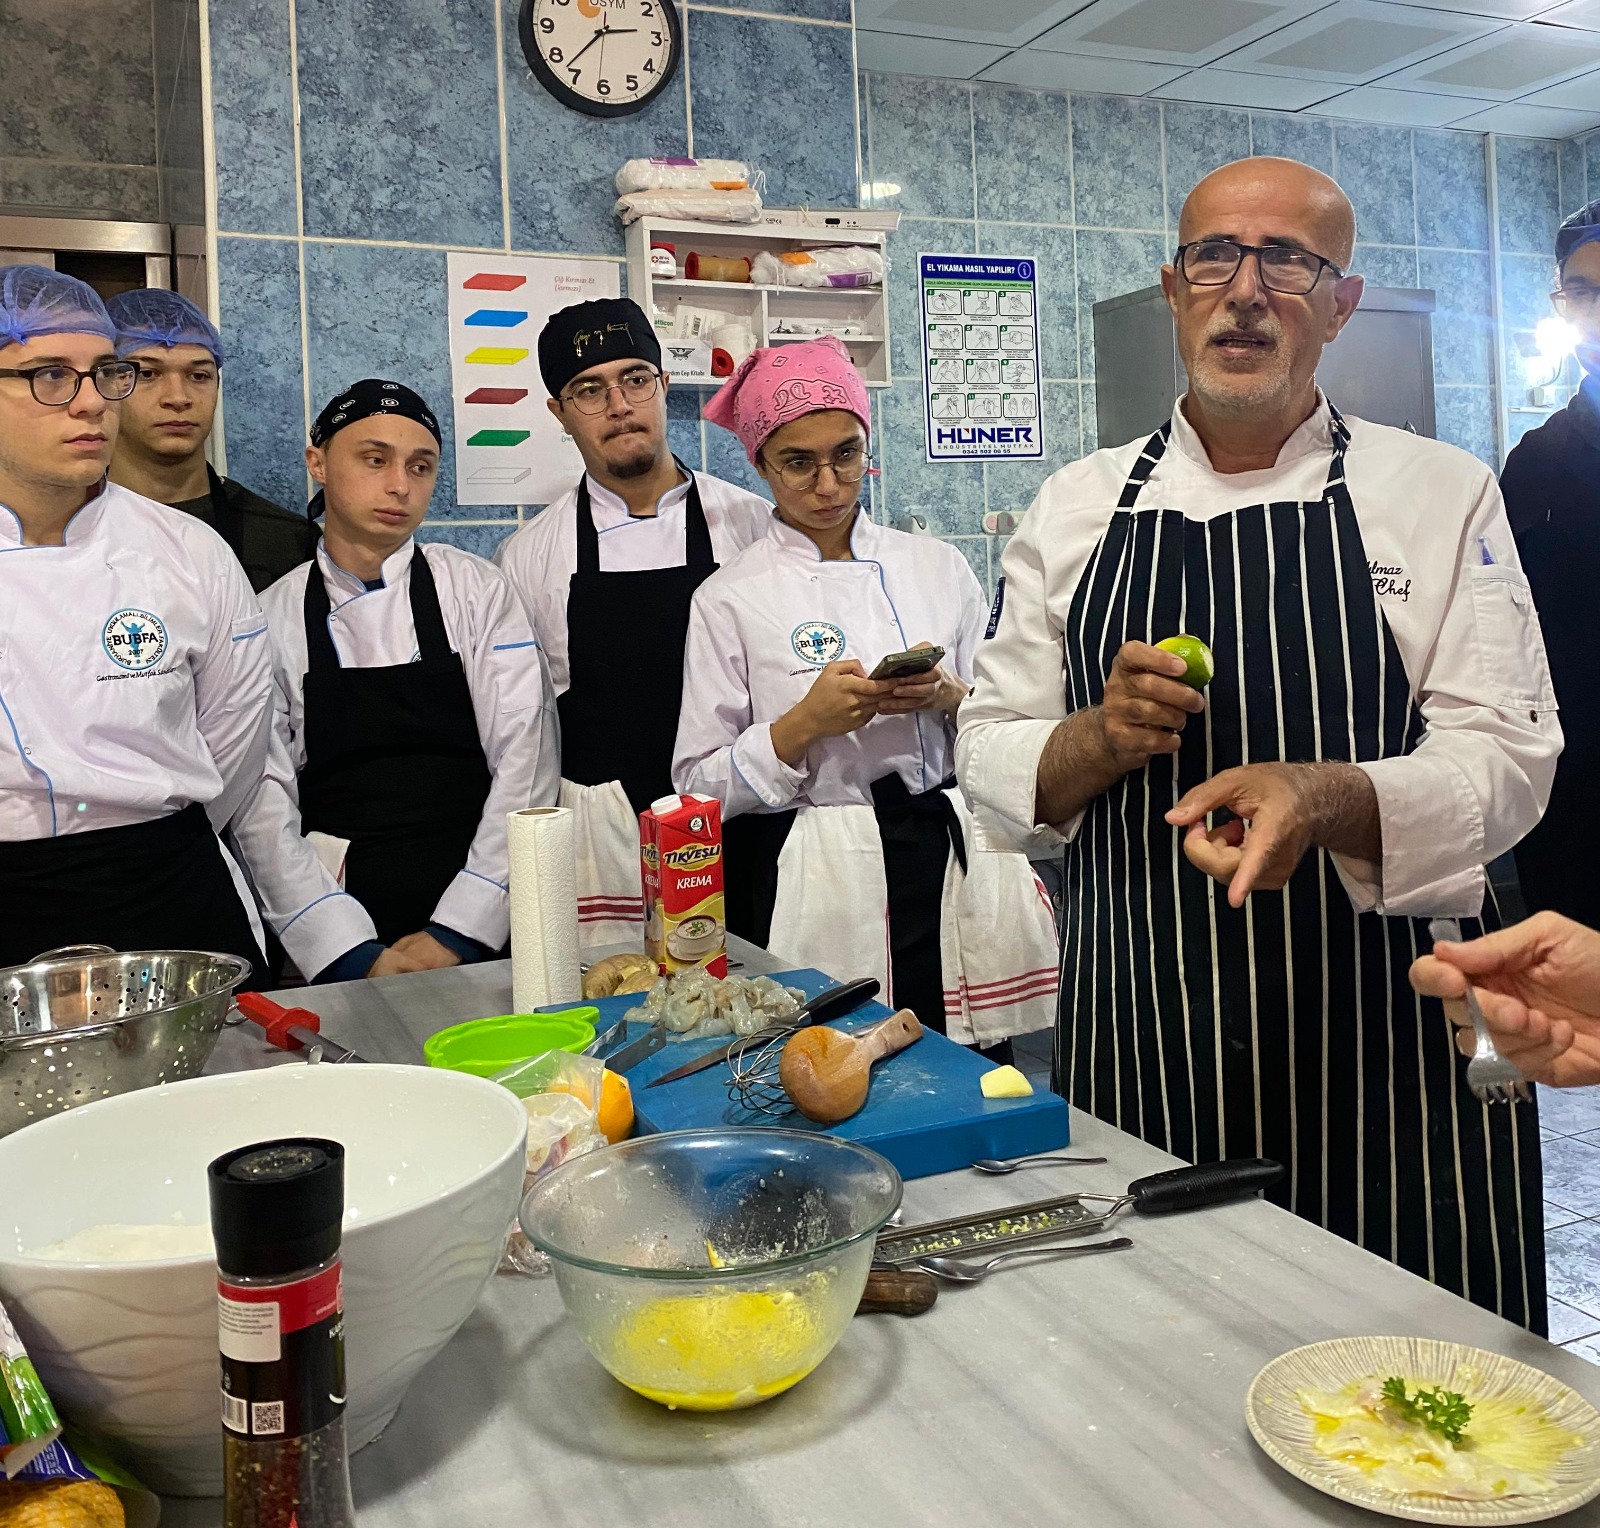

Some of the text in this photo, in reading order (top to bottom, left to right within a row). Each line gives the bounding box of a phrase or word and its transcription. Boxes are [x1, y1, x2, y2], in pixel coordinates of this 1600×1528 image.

[640, 1, 654, 17] 2
[539, 17, 555, 34] 9
[651, 31, 662, 46] 3
[549, 47, 563, 63] 8
[643, 58, 655, 74] 4
[568, 68, 582, 85] 7
[626, 75, 638, 91] 5
[597, 79, 611, 95] 6
[927, 263, 1015, 274] EL YIKAMA NASIL YAPILIR?
[654, 319, 674, 327] atticon
[1367, 560, 1403, 575] lmaz
[1372, 577, 1412, 602] Chef
[112, 632, 159, 646] BUBFA
[799, 636, 838, 648] BUBFA
[677, 874, 712, 890] KREMA
